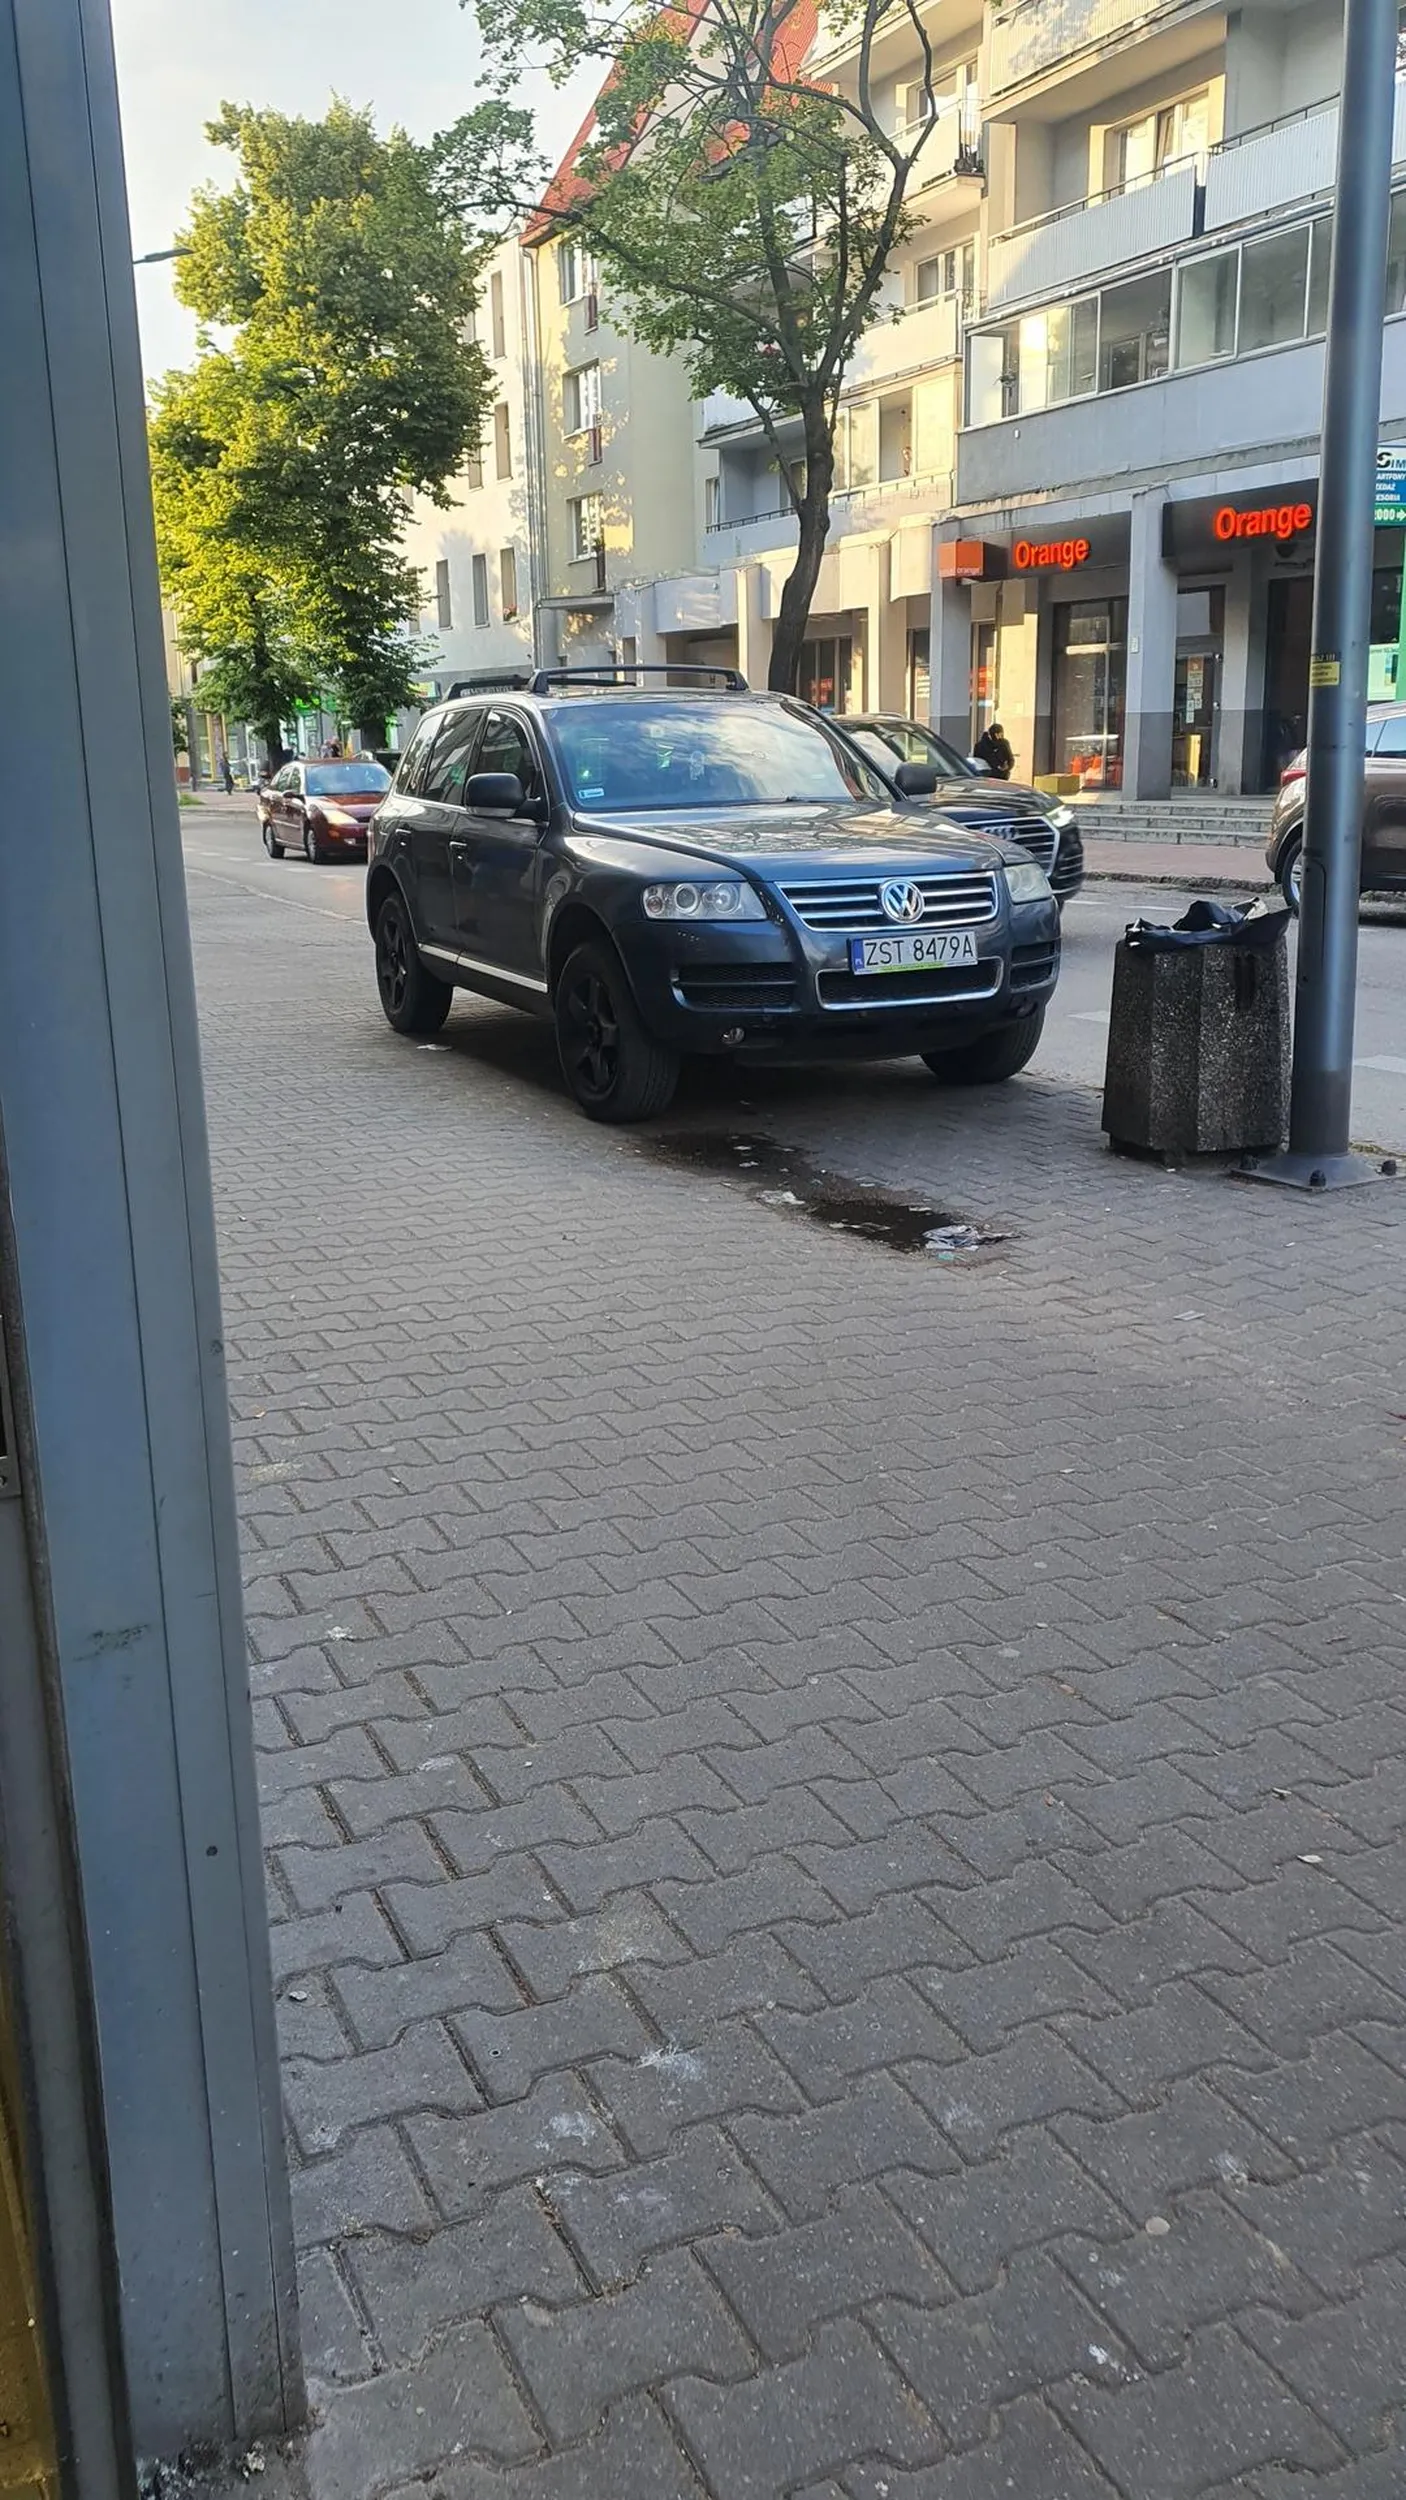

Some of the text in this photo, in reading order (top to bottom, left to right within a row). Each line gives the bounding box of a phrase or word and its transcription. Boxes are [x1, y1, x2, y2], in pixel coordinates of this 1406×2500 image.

[1216, 504, 1311, 538] Orange
[1015, 539, 1088, 569] Orange
[865, 935, 974, 966] ZST 8479A
